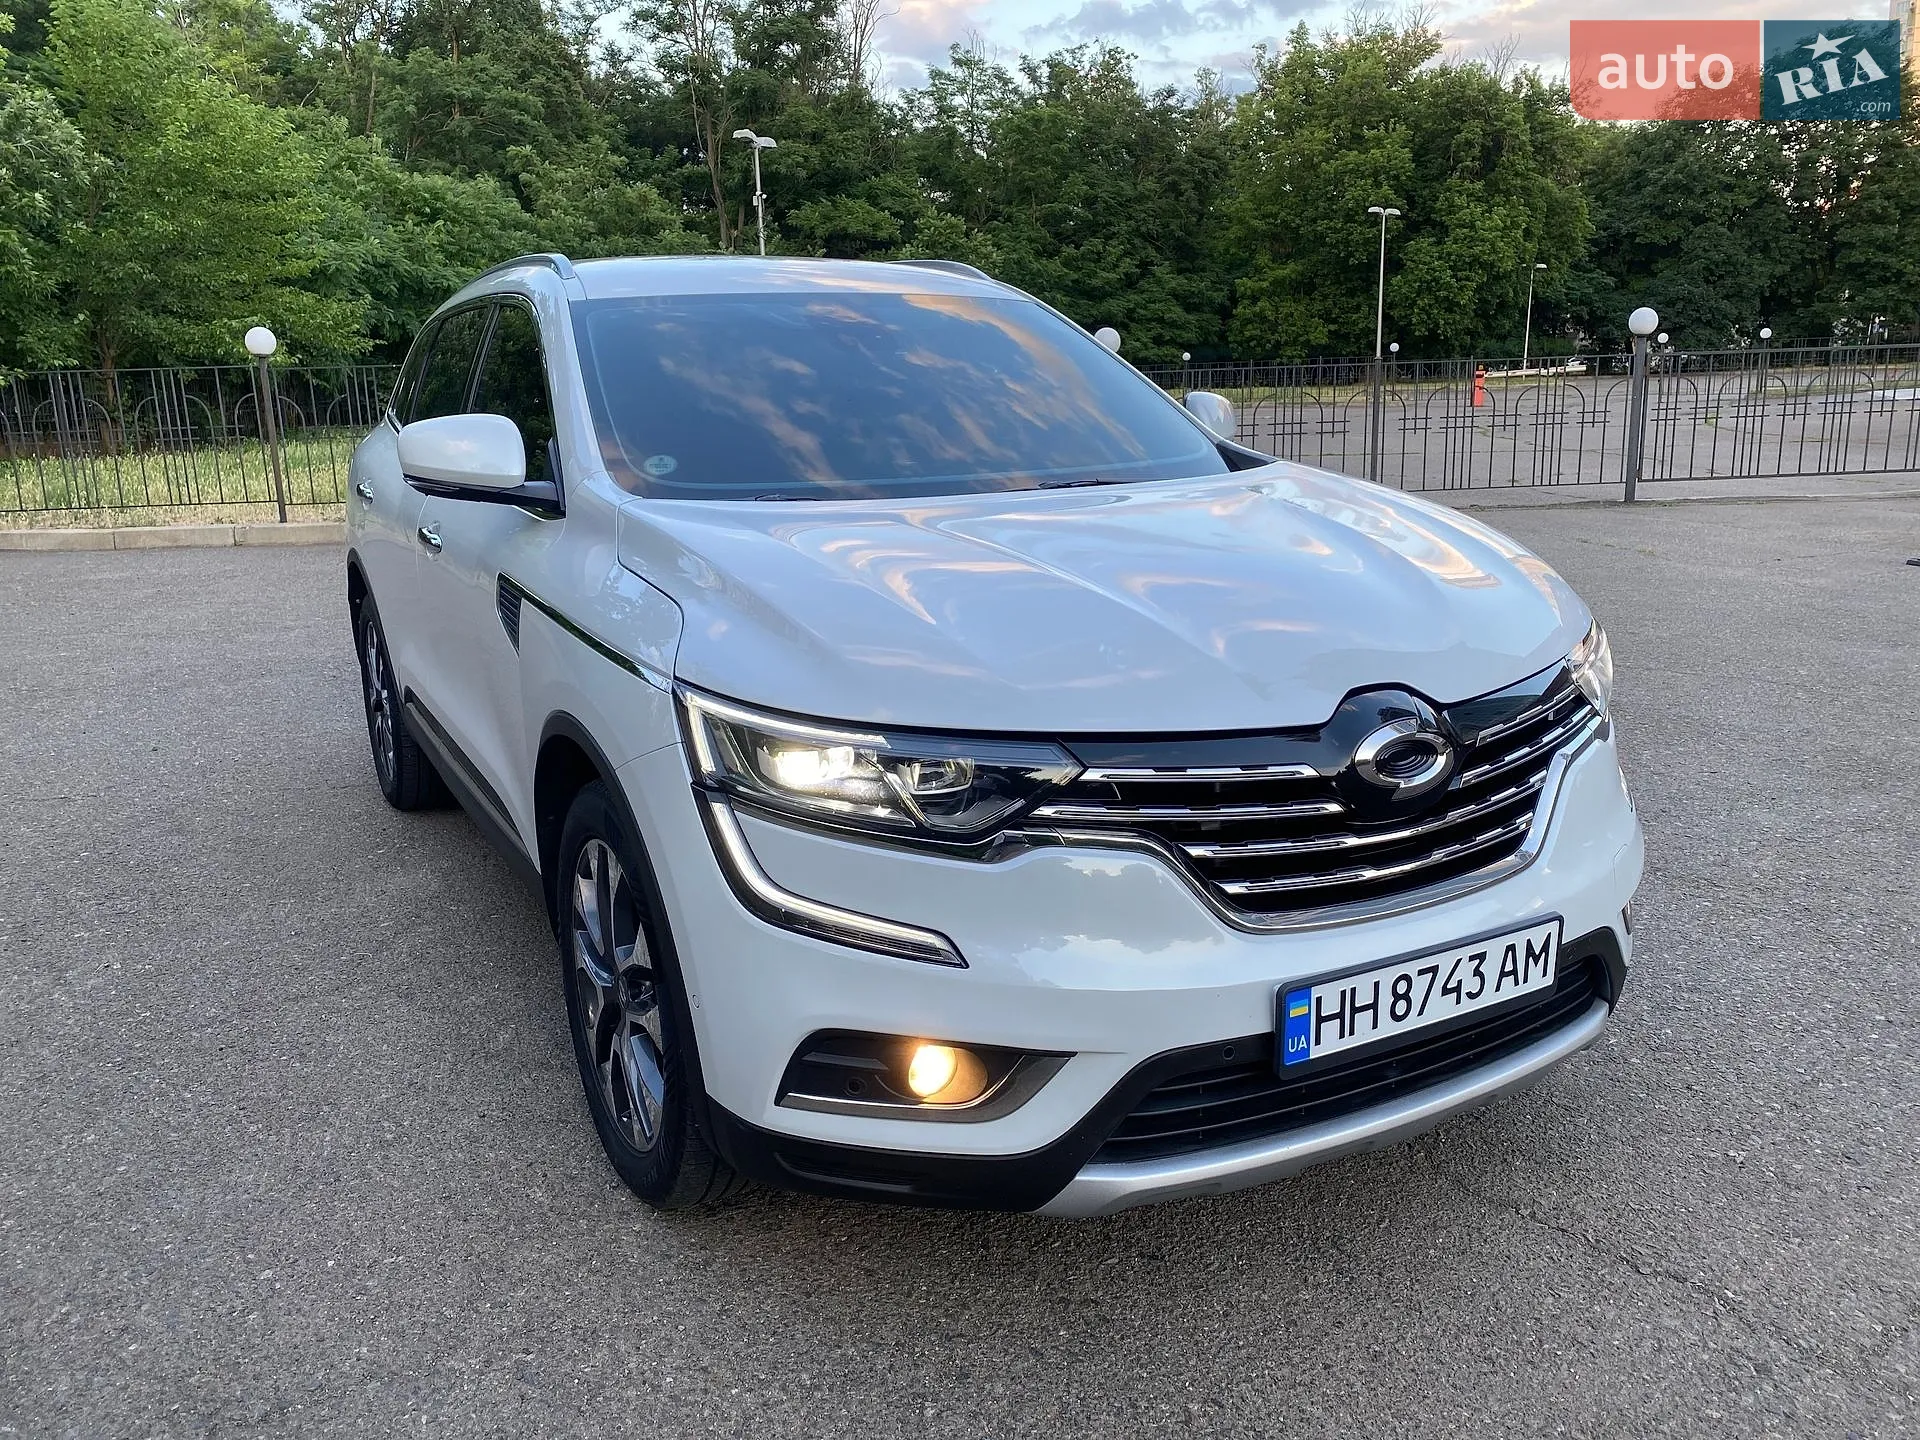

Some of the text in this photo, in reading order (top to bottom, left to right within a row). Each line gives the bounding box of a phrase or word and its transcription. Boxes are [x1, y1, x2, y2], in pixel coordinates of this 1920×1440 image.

[1314, 931, 1553, 1046] HH 8743 AM
[1288, 1034, 1308, 1053] UA
